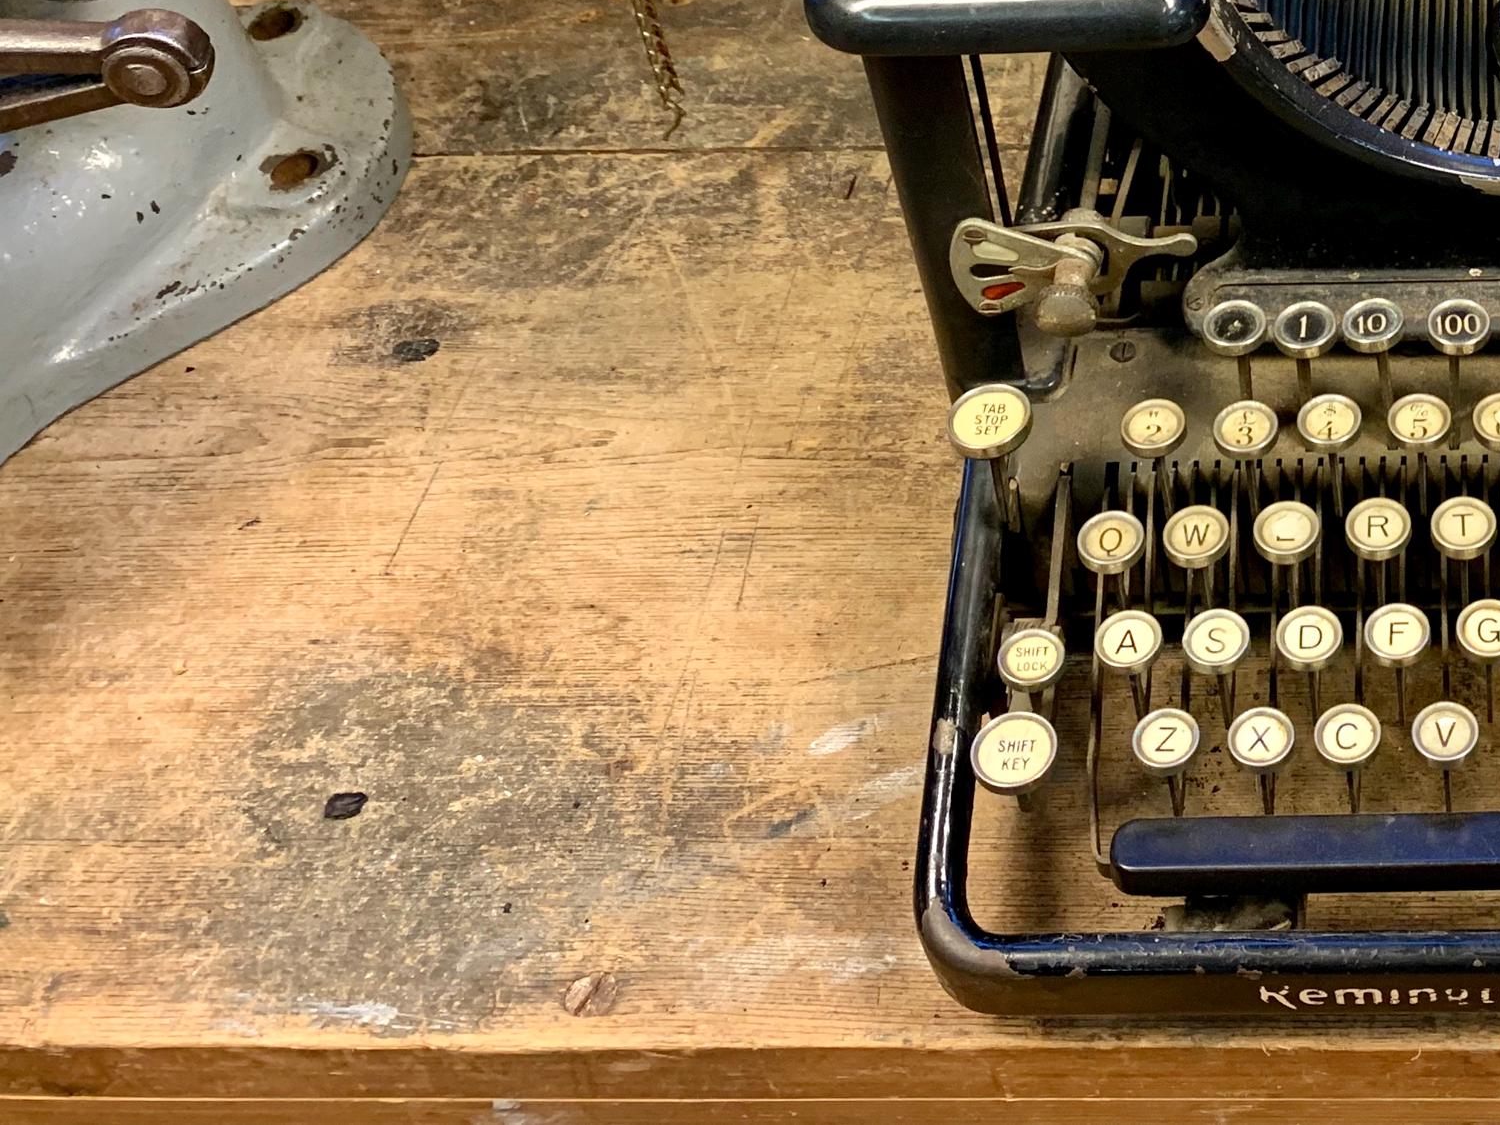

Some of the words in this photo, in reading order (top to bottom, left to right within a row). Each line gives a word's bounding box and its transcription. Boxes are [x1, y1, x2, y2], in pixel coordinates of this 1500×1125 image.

[1299, 314, 1308, 338] 1
[1356, 313, 1387, 335] 10
[1436, 313, 1482, 336] 100
[974, 414, 1009, 425] STOP
[982, 403, 1006, 414] TAB
[974, 425, 1000, 435] SET
[1142, 424, 1162, 443] 2
[1236, 427, 1253, 445] 3
[1317, 421, 1338, 440] 4
[1410, 418, 1428, 438] 5
[1183, 523, 1210, 547] W
[1367, 515, 1389, 538] R
[1452, 513, 1474, 537] T
[1099, 527, 1122, 556] Q
[1115, 629, 1138, 654] A
[1205, 627, 1227, 654] S
[1299, 625, 1323, 649] D
[1389, 622, 1409, 646] F
[1477, 618, 1500, 643] G
[1015, 646, 1049, 658] SHIFT
[1016, 661, 1048, 673] LOCK
[998, 739, 1037, 753] SHIFT
[1154, 727, 1178, 752] Z
[1248, 726, 1271, 752] X
[1335, 722, 1358, 750] C
[1435, 721, 1456, 748] V
[1001, 758, 1030, 771] KEY
